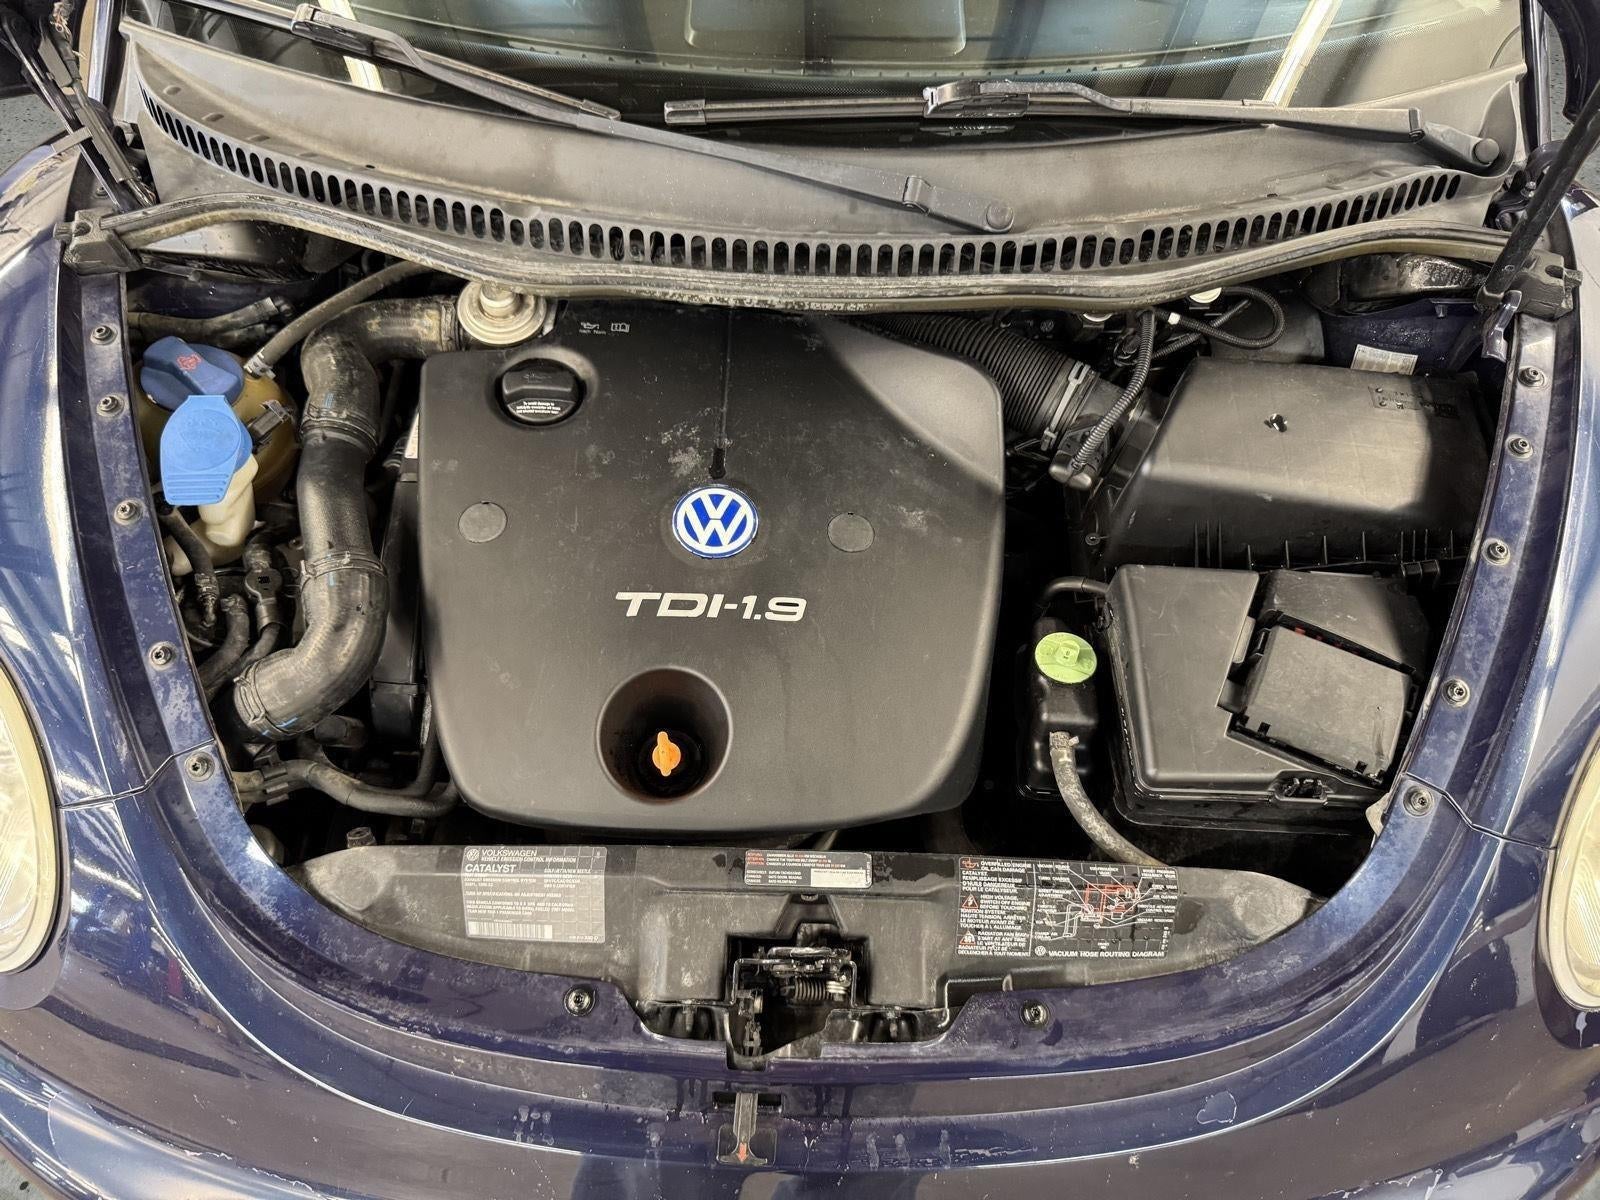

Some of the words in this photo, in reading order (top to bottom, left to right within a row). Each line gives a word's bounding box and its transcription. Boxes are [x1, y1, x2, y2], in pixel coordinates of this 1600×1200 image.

[615, 591, 807, 622] TDI-1.9
[482, 849, 538, 857] VOLKSWAGEN
[465, 863, 517, 873] CATALYST
[1048, 950, 1078, 958] VACUUM
[1080, 950, 1099, 958] HOSE
[1100, 950, 1131, 958] ROUTING
[1132, 950, 1165, 958] DIAGRAM
